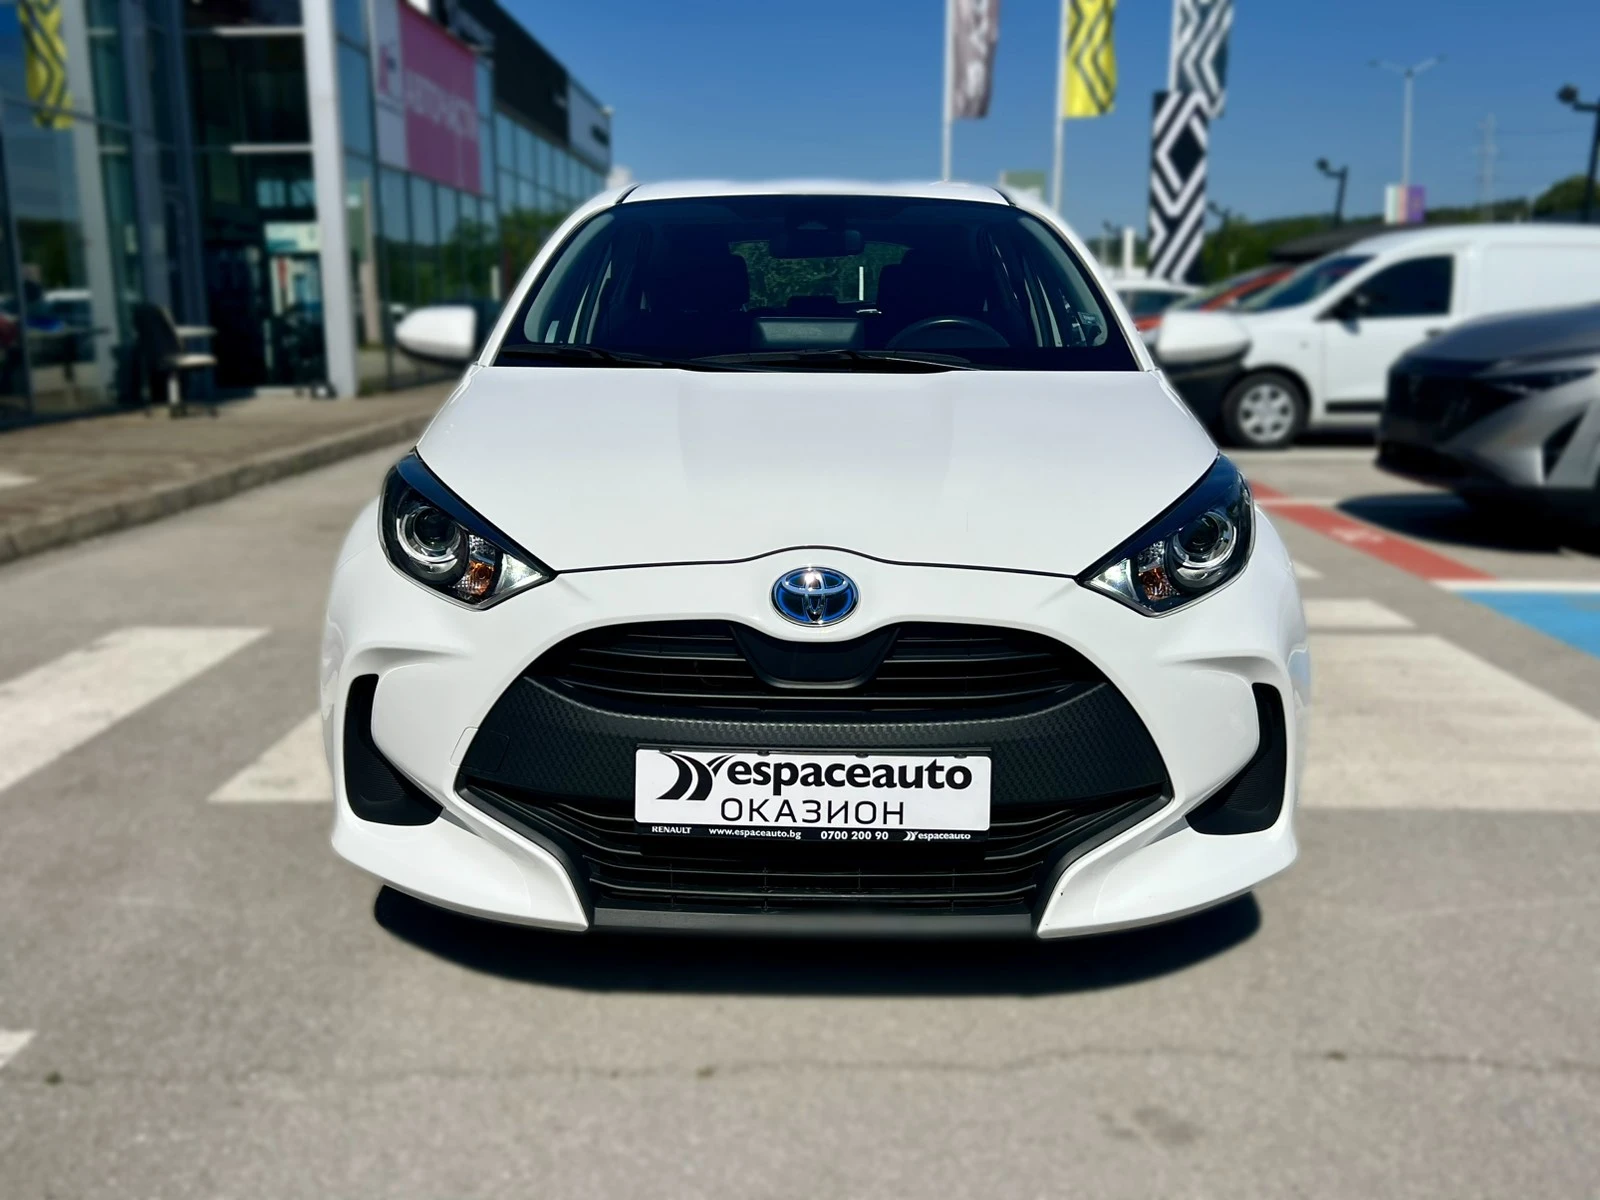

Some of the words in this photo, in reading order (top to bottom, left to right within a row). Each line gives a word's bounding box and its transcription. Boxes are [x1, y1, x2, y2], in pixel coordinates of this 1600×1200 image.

[727, 759, 973, 796] espaceauto
[721, 798, 904, 825] ОКАЗИОН
[651, 825, 692, 834] RENAULT
[708, 827, 802, 839] www.espaceauto.bg
[820, 830, 848, 840] 0700
[851, 830, 872, 840] 200
[875, 830, 889, 840] 90
[918, 832, 971, 841] espaceauto
